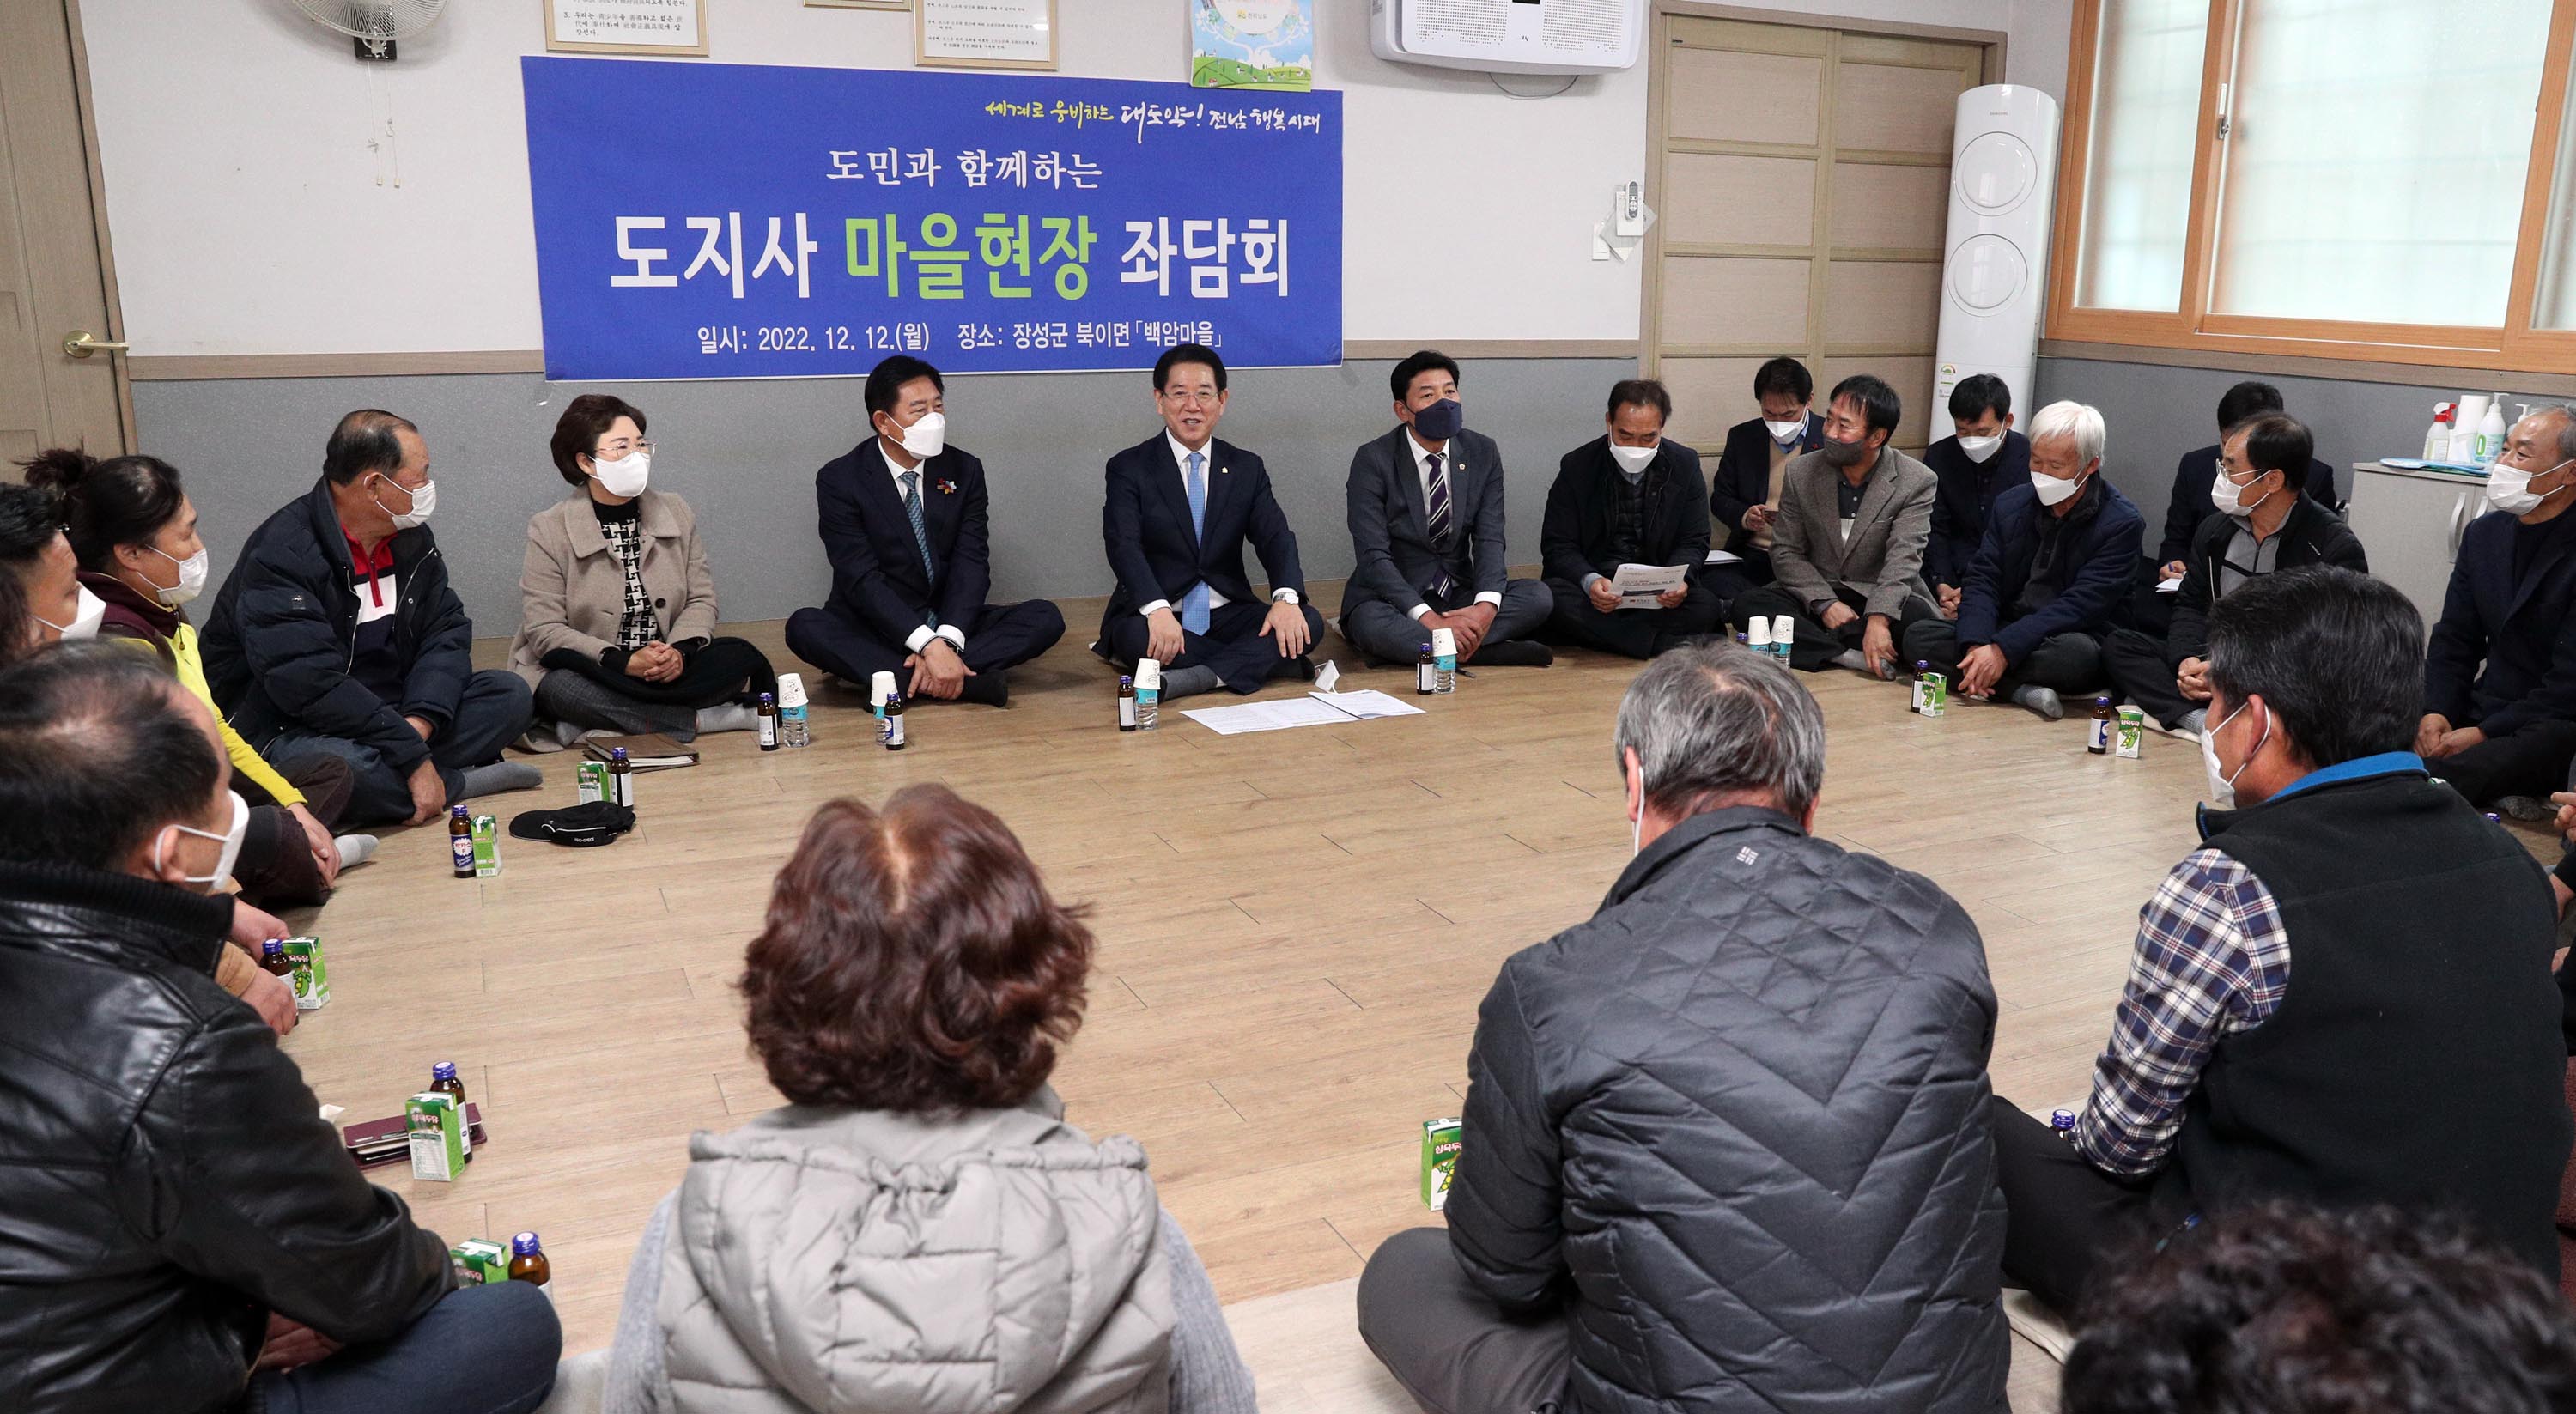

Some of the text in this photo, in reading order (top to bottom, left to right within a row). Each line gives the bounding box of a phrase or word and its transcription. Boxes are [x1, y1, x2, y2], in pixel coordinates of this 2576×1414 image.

[984, 100, 1321, 145] 세계로 웅비하는 대도약! 전남 행복 시대
[825, 147, 1103, 191] 도민과 함께하는
[610, 211, 1288, 300] 도지사 마을현장 좌담회
[697, 325, 748, 355] 일시:
[757, 326, 816, 352] 2022.
[825, 325, 855, 351] 12.
[957, 322, 1003, 350] 장소:
[1012, 322, 1069, 349] 장성군
